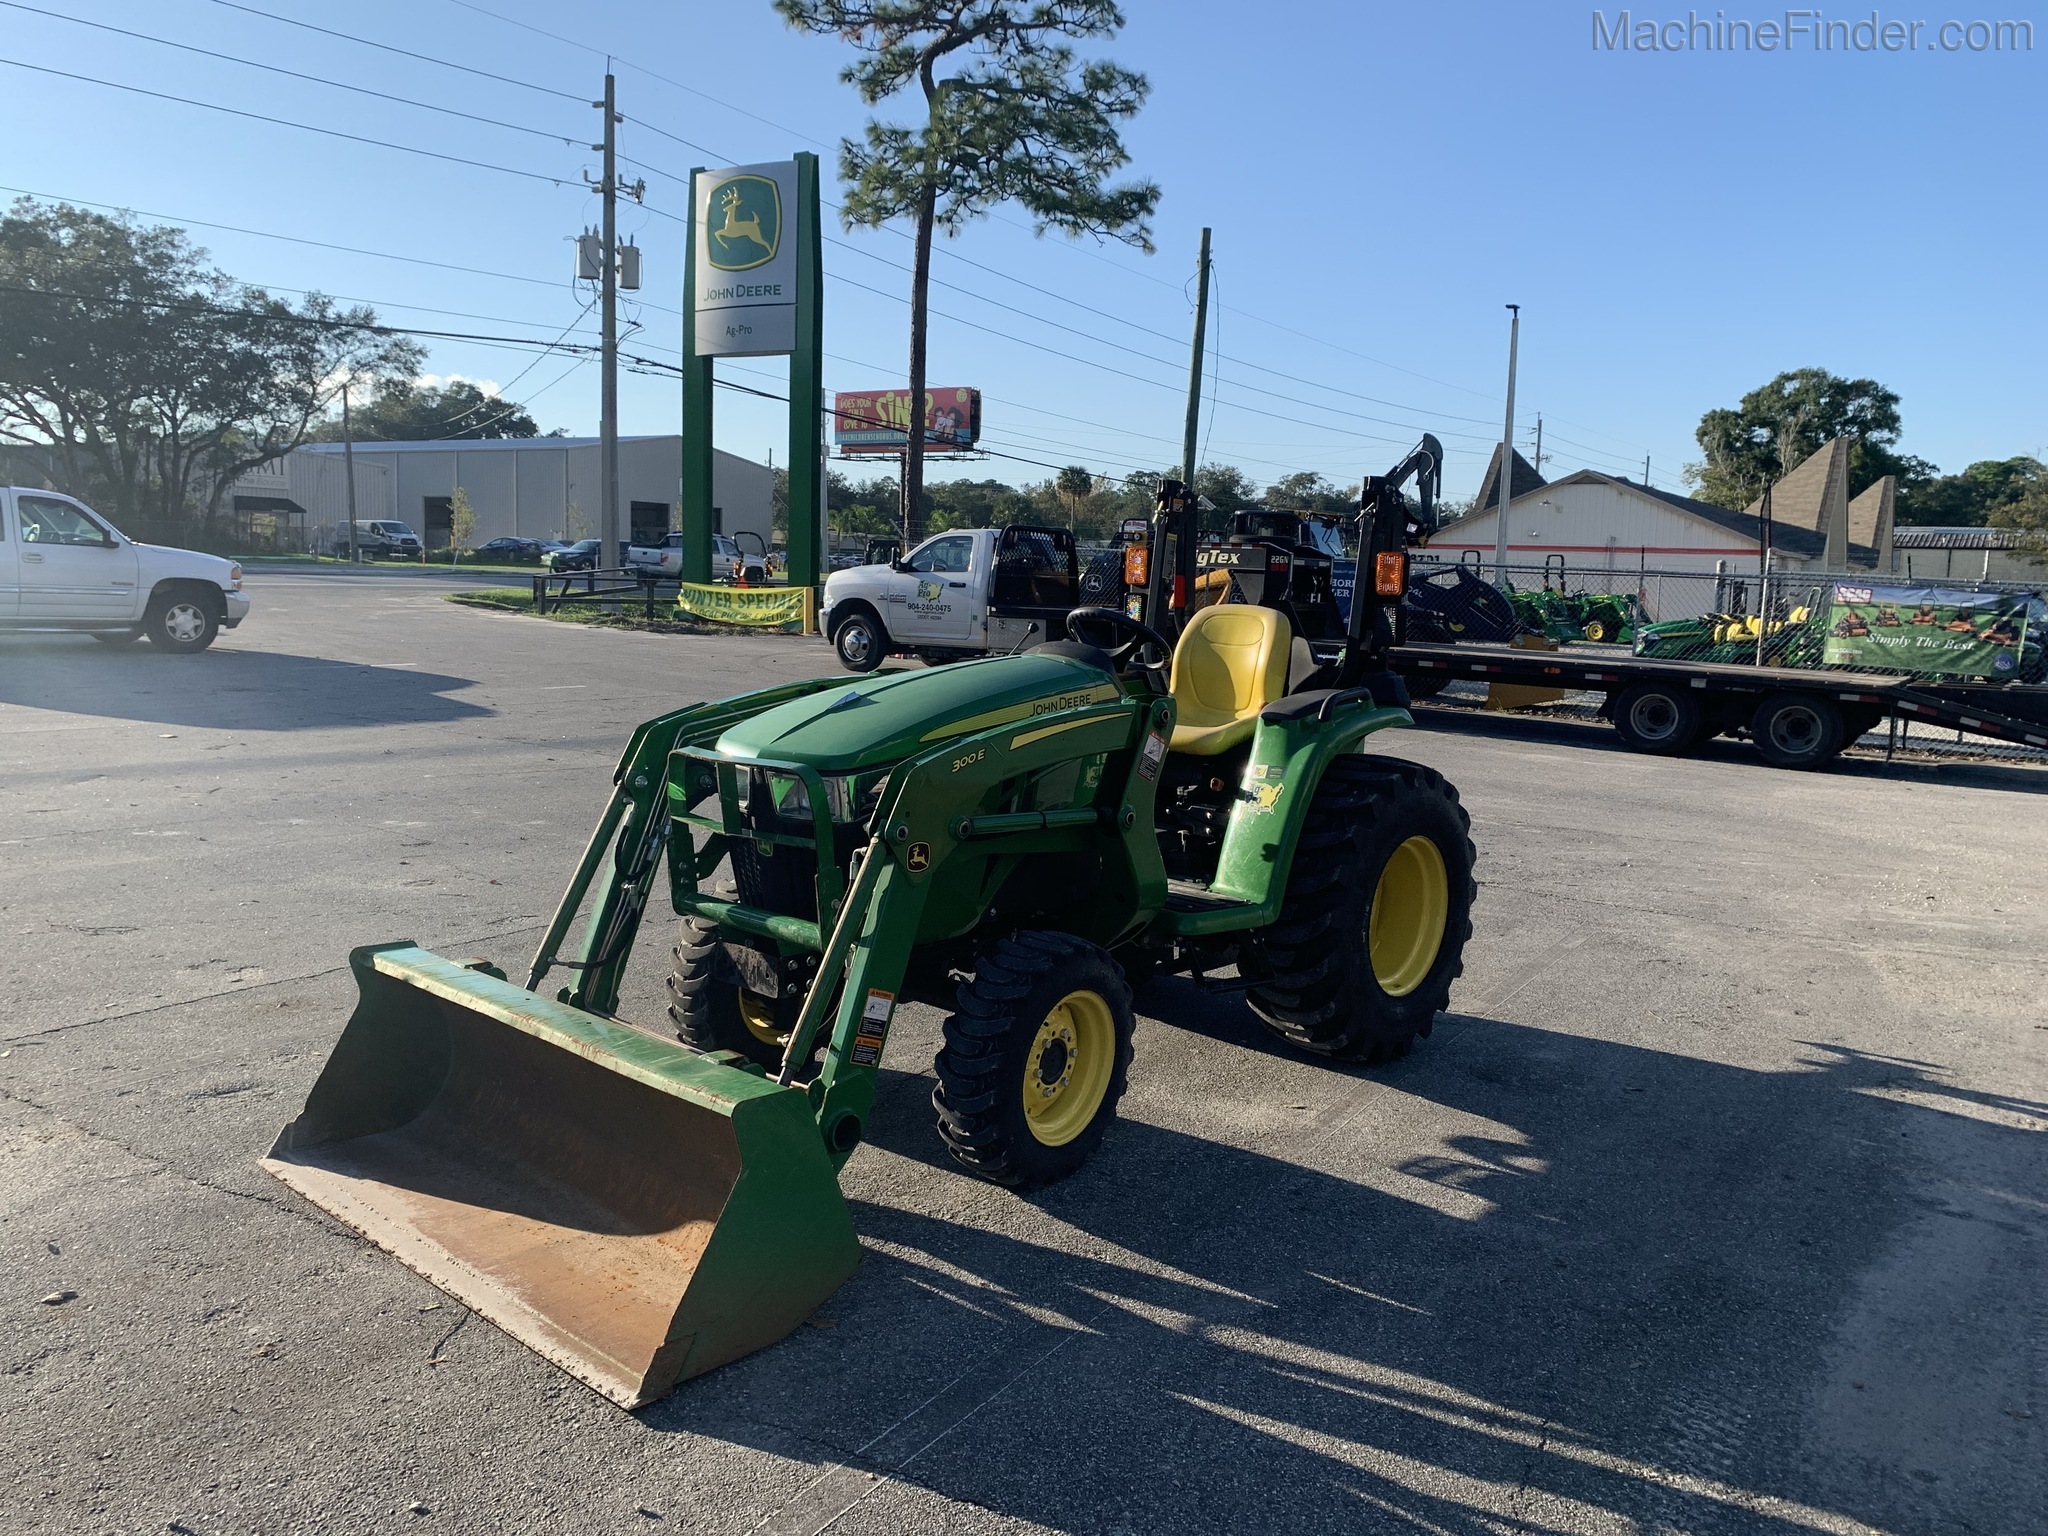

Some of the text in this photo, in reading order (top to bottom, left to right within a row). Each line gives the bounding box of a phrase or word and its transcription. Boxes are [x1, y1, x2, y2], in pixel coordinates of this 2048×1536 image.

[704, 285, 782, 301] JOHN DEERE
[726, 324, 753, 337] Ag-Pro
[917, 589, 931, 598] Pro
[1866, 632, 1911, 648] Simply
[1916, 636, 1939, 648] The
[1029, 694, 1092, 717] JOHN DEERE
